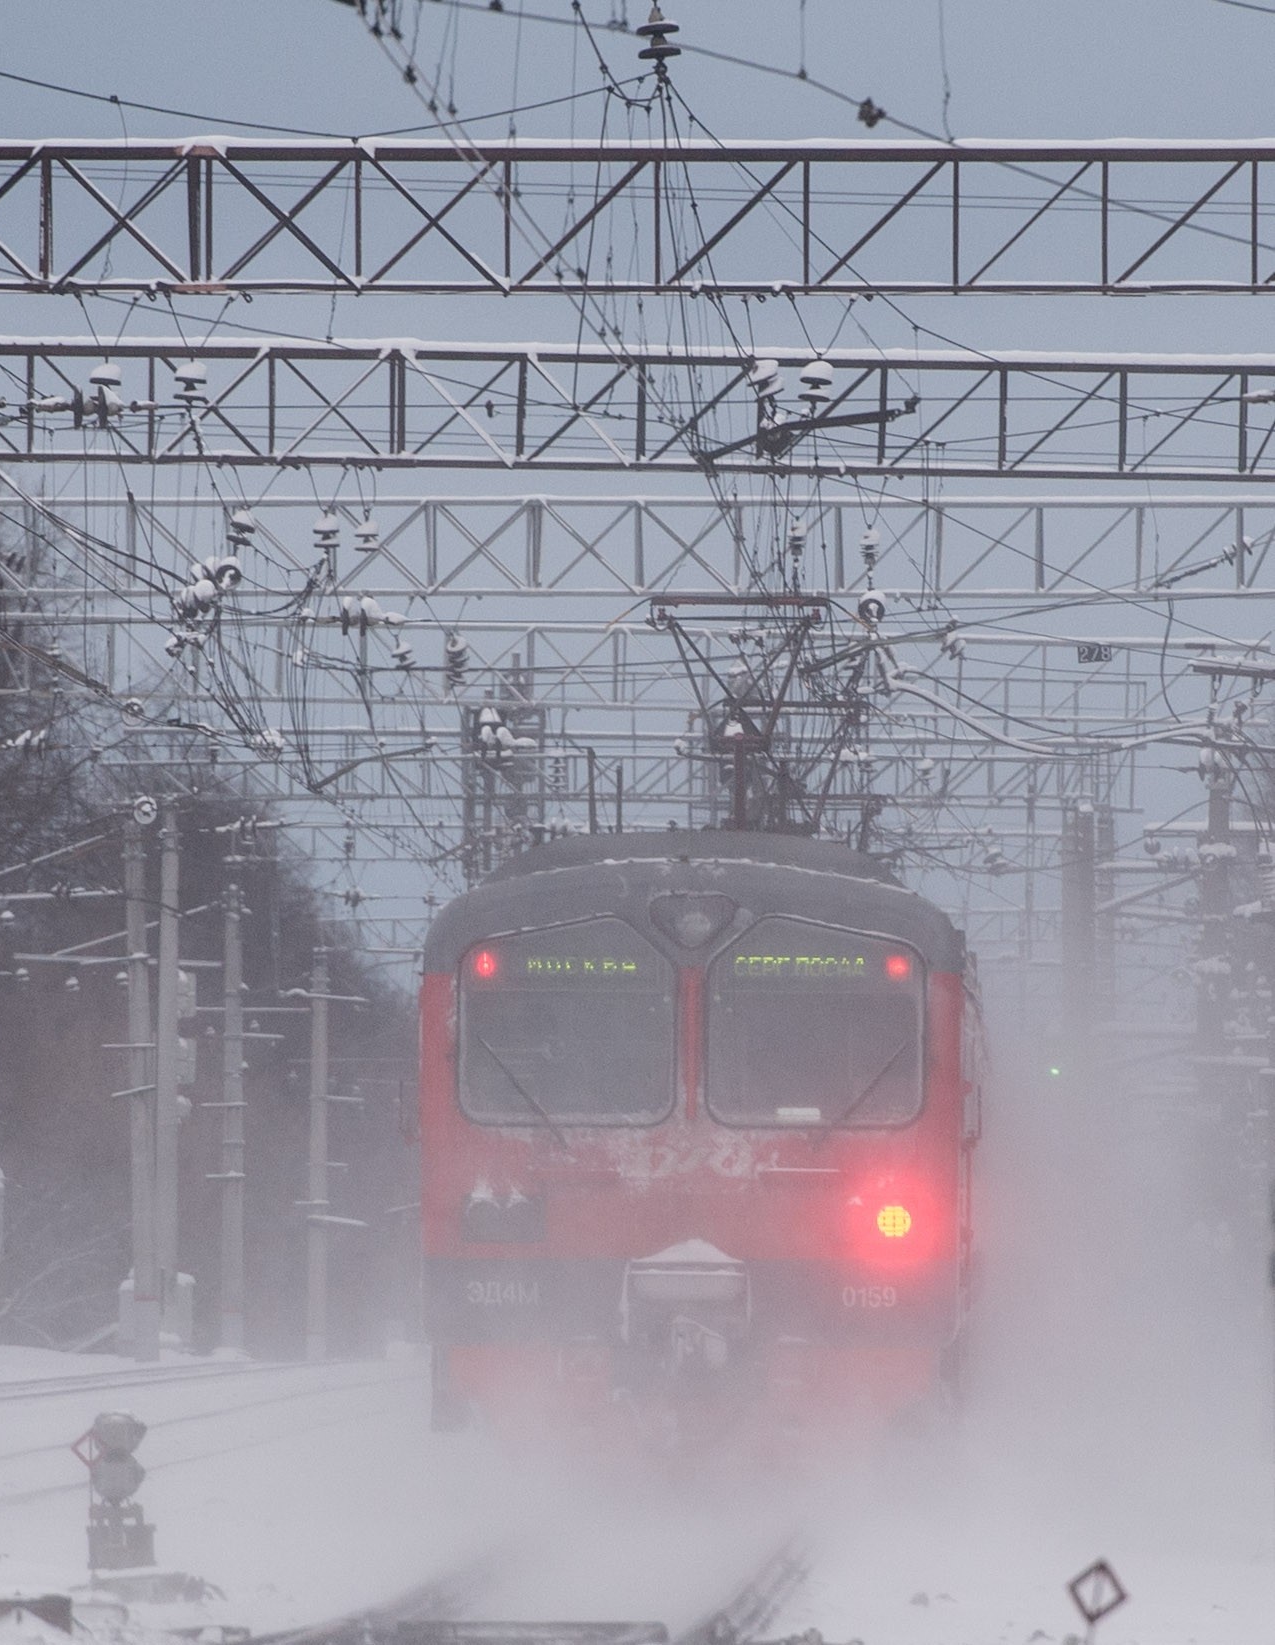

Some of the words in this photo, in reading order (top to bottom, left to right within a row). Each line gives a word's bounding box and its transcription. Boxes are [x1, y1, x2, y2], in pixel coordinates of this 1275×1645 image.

[1079, 646, 1111, 662] 278
[527, 956, 637, 975] МОСКВА
[467, 1281, 540, 1304] ЭД4М
[842, 1286, 896, 1308] 0159
